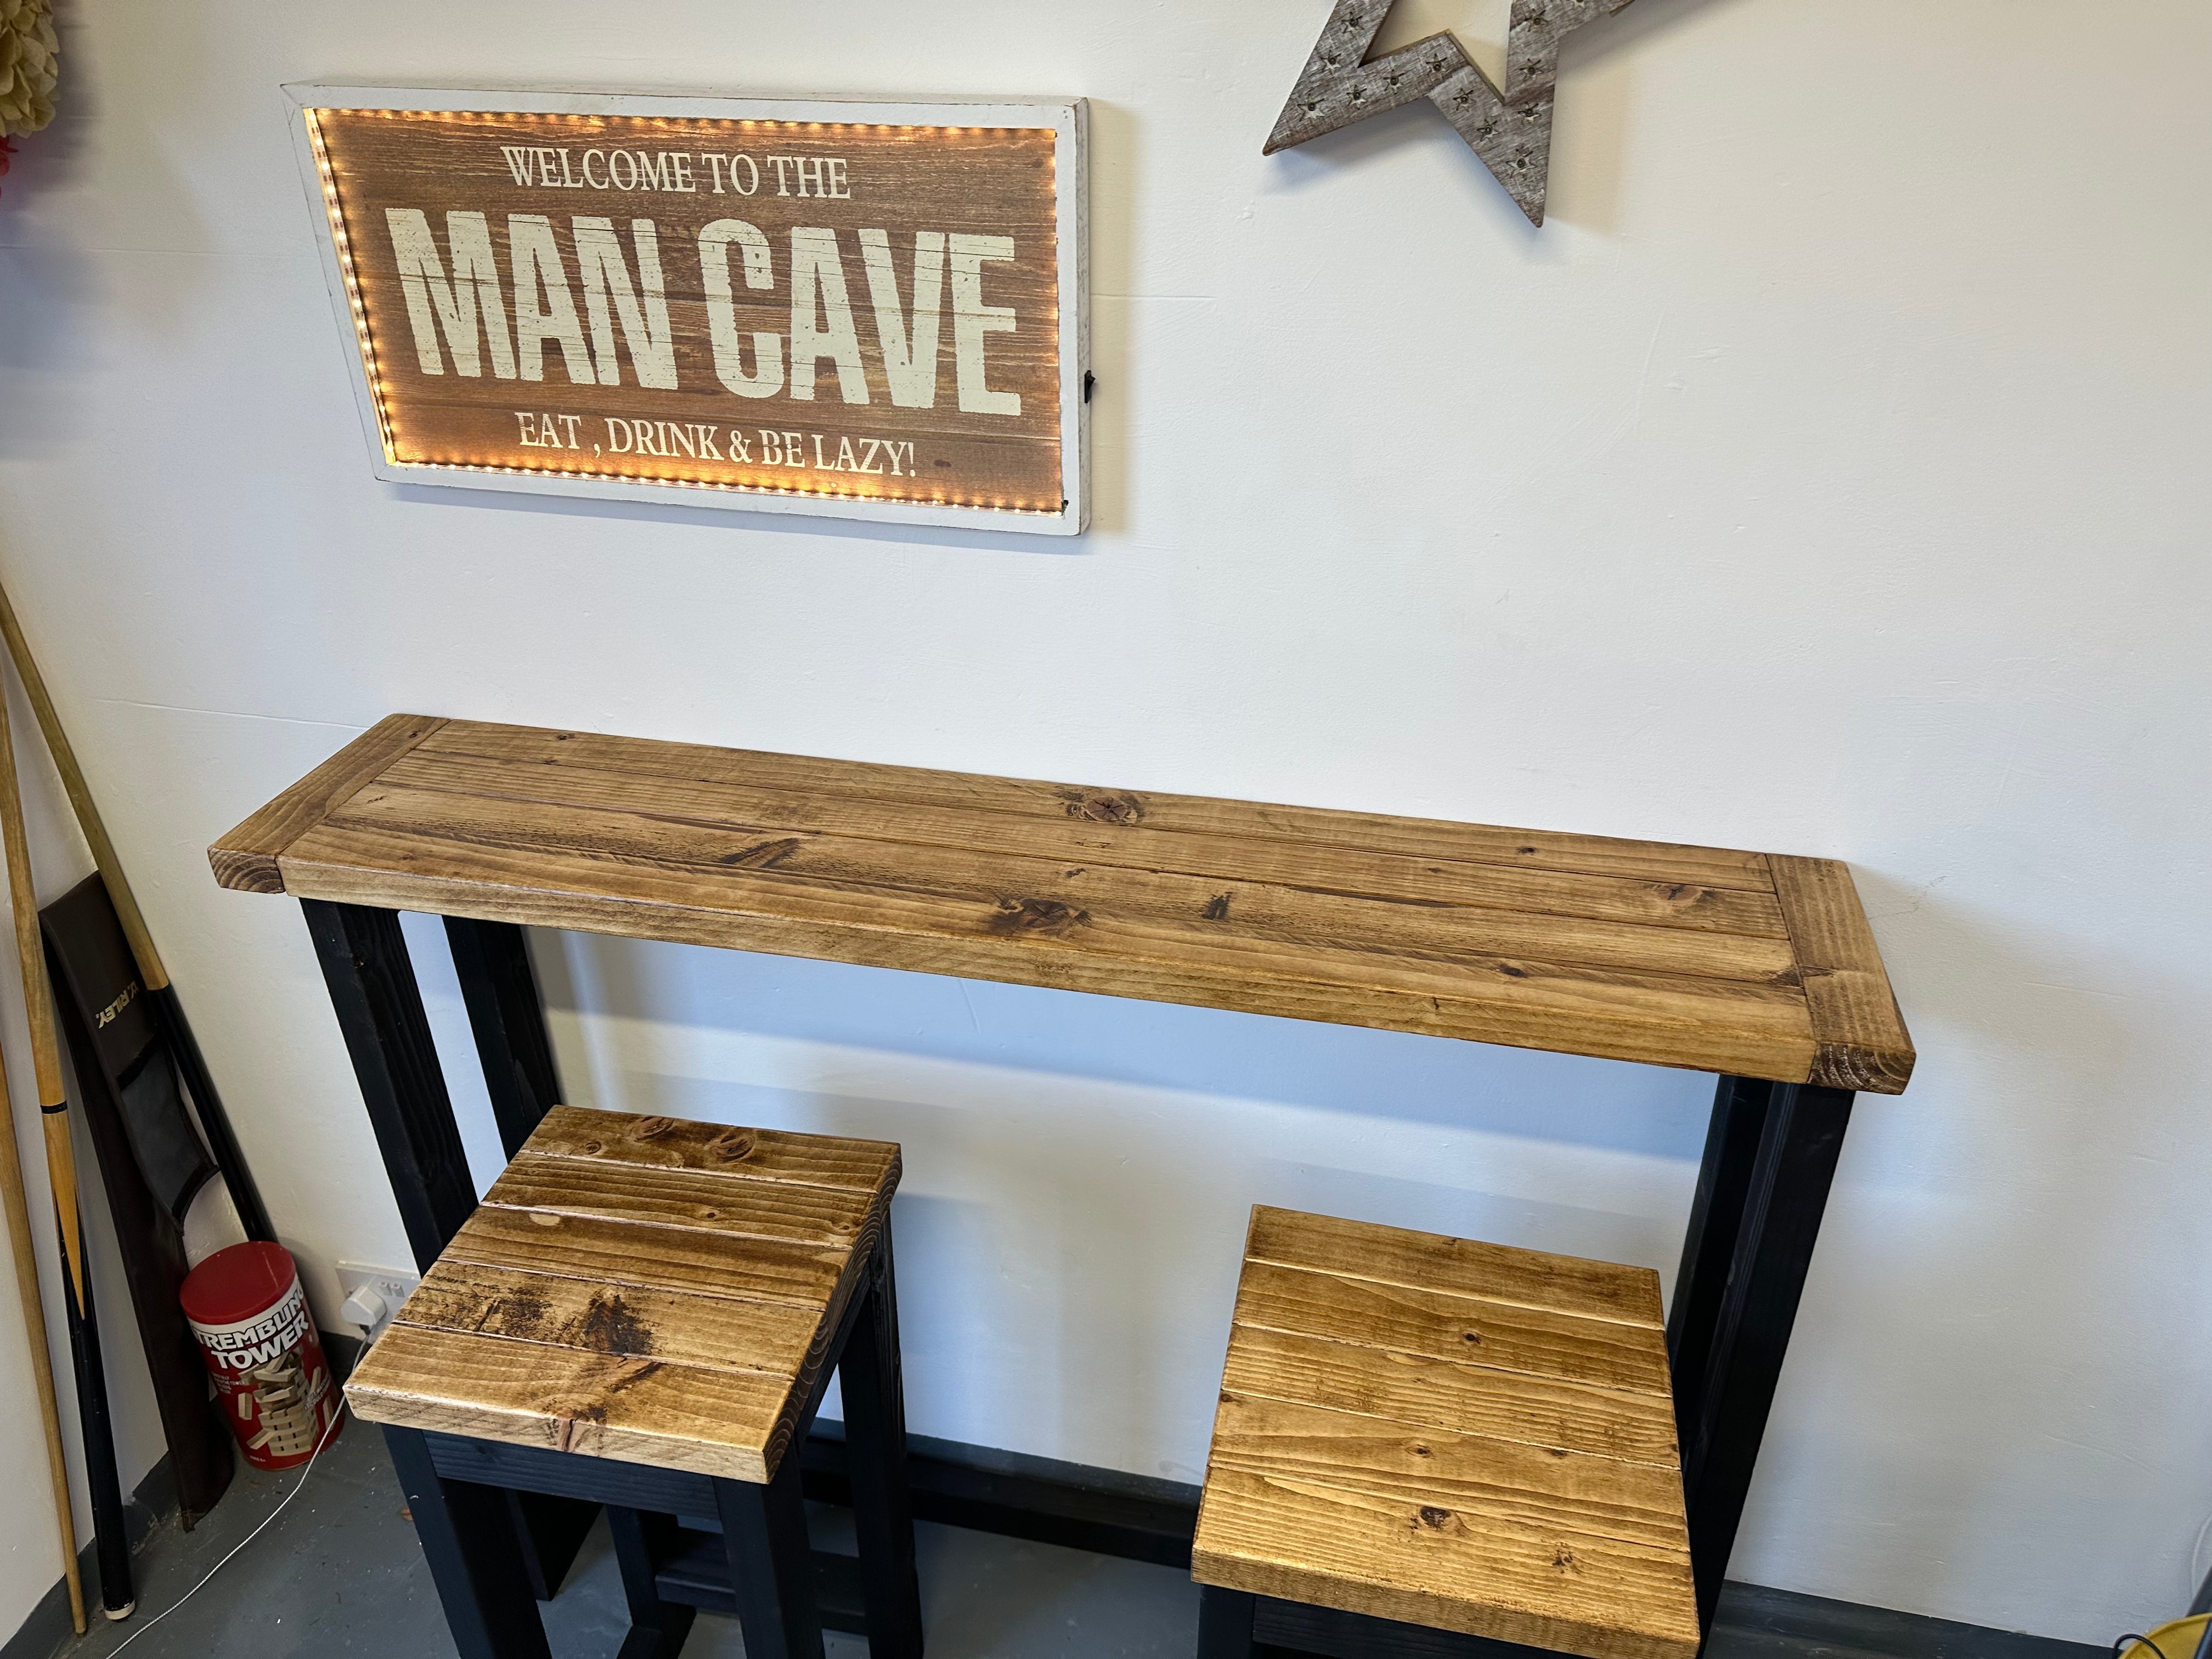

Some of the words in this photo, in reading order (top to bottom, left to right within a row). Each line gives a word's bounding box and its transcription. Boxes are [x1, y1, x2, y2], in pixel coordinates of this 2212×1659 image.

[500, 145, 696, 193] WELCOME
[702, 152, 759, 196] TO
[767, 155, 850, 199] THE
[385, 208, 678, 390] MAN
[698, 218, 1021, 416] CAVE
[605, 417, 724, 461] DRINK
[729, 430, 752, 463] &
[758, 429, 805, 466] BE
[811, 434, 916, 477] LAZY!
[211, 1310, 309, 1369] TOWER
